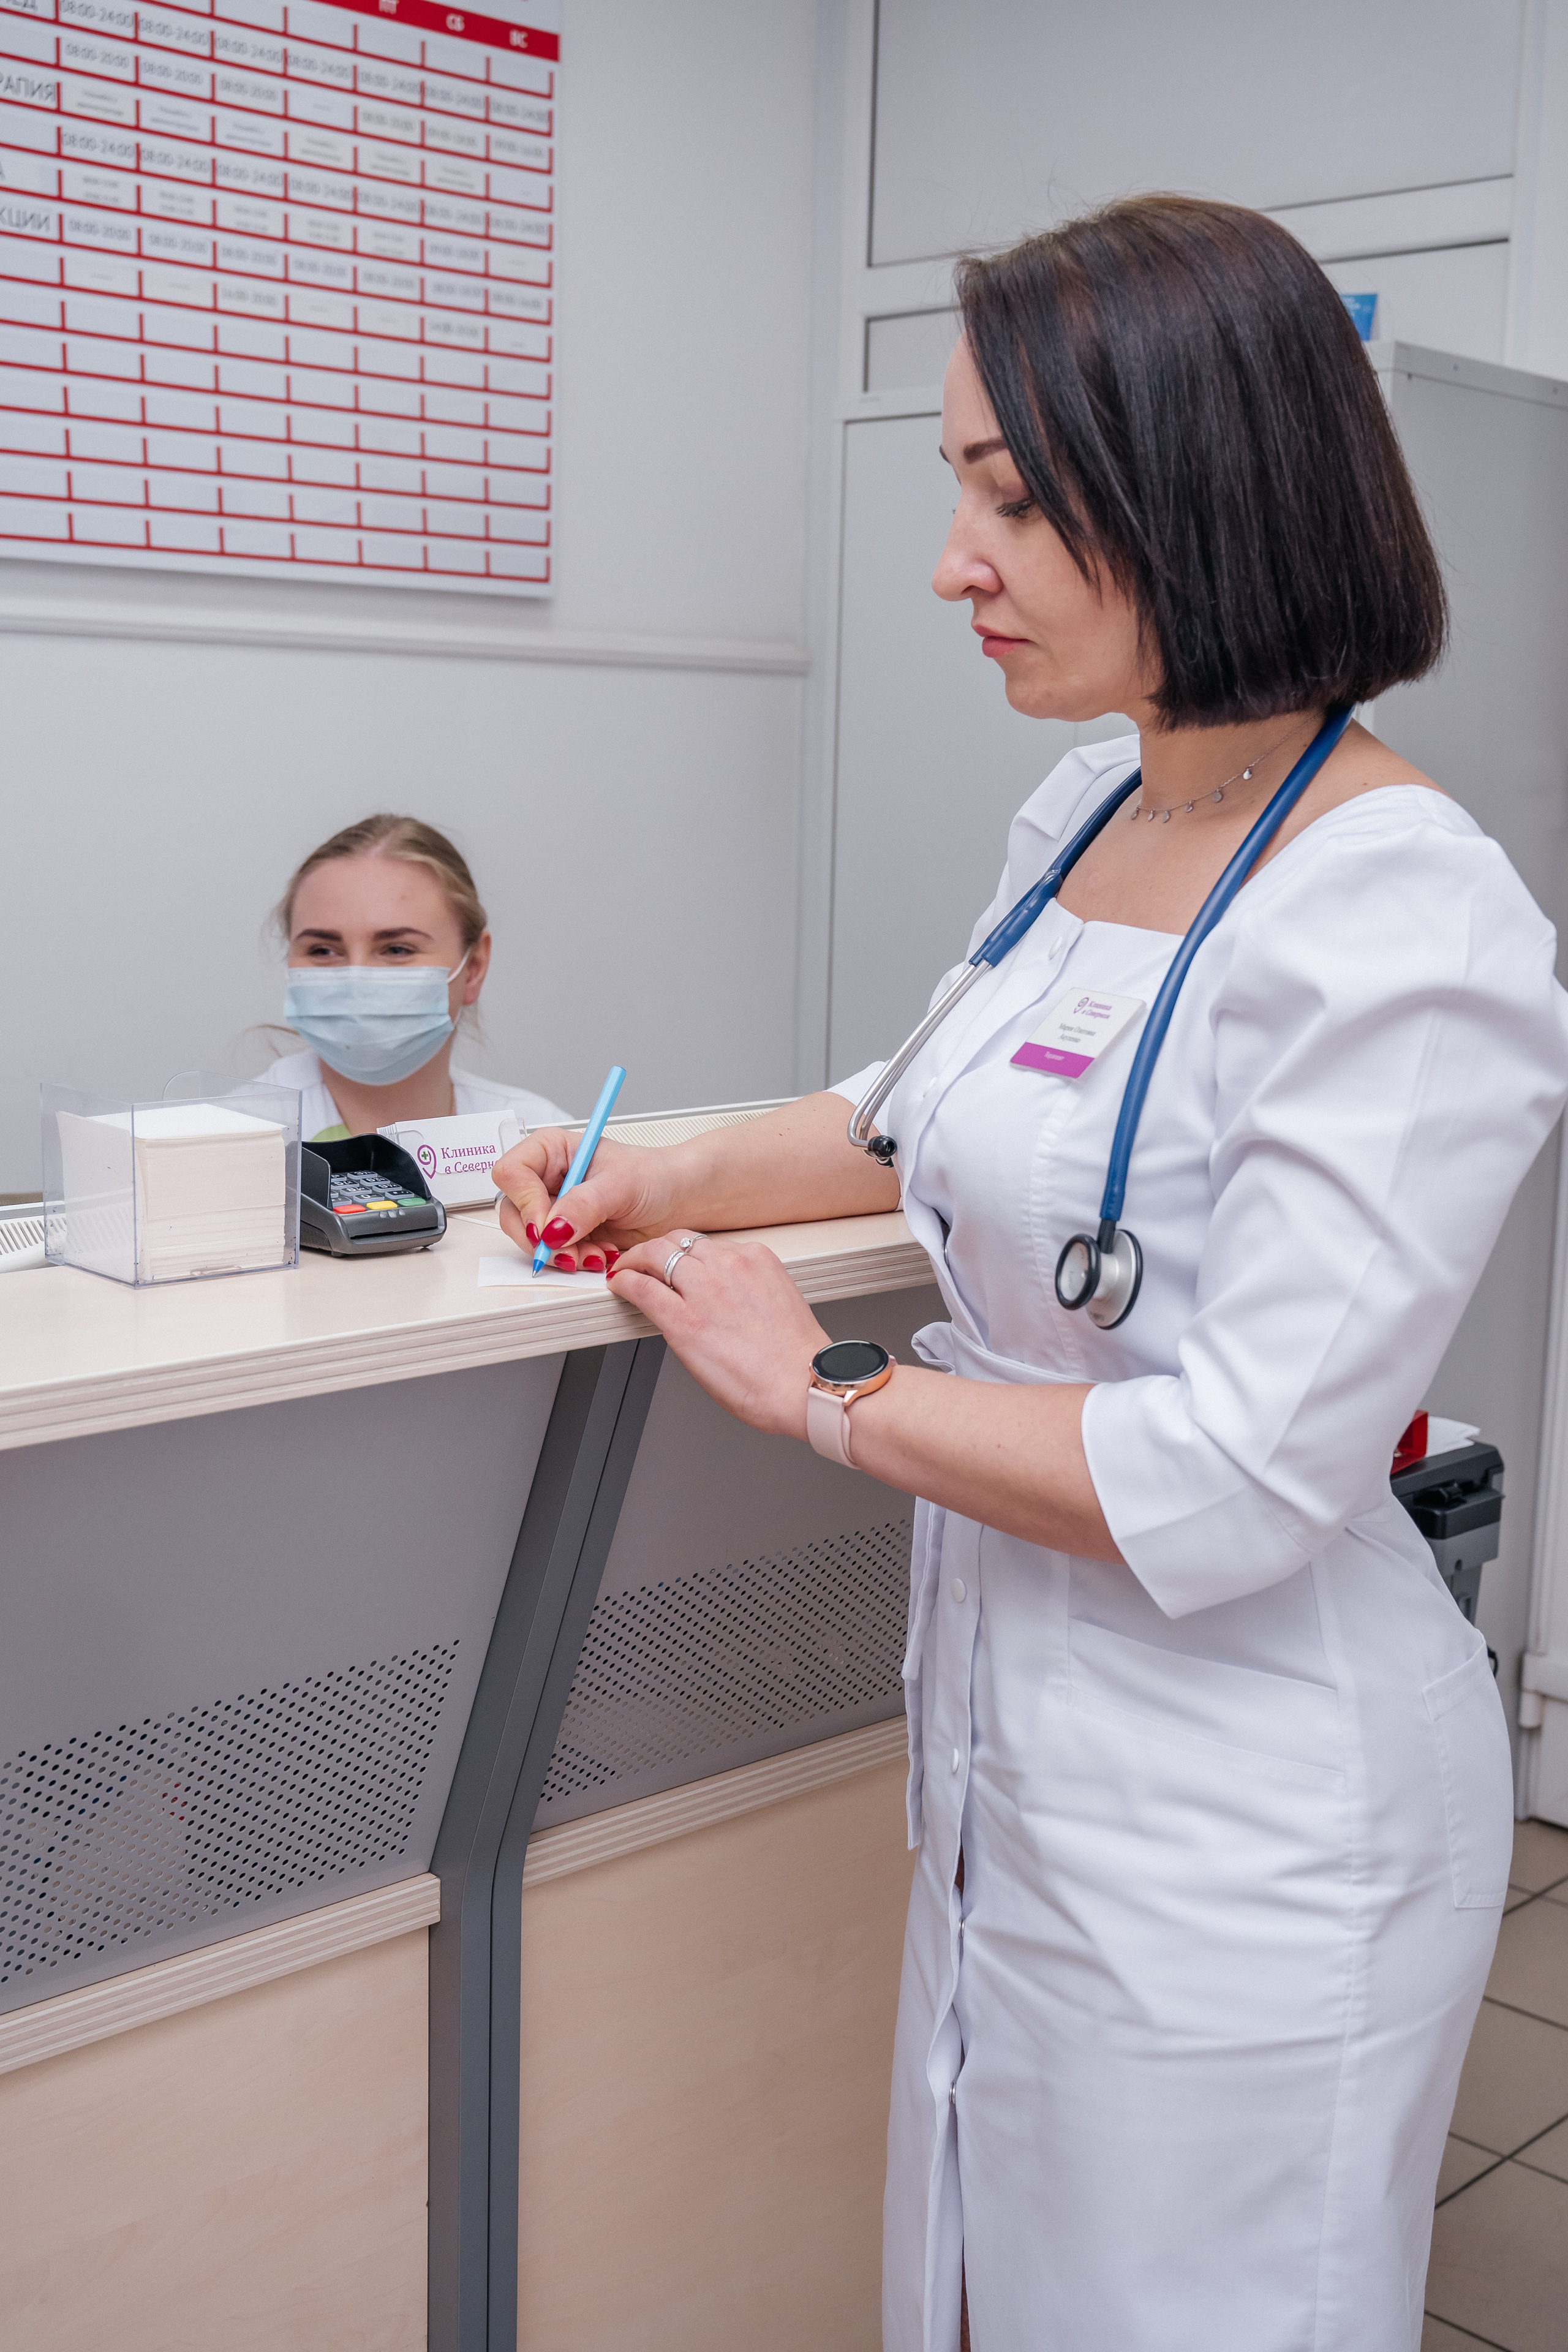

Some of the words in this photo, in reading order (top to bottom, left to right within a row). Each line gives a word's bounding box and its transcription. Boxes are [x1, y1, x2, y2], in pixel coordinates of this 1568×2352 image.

[440, 1145, 496, 1159] Клиника
[445, 1166, 451, 1174] в
[454, 1161, 496, 1174] Северн
